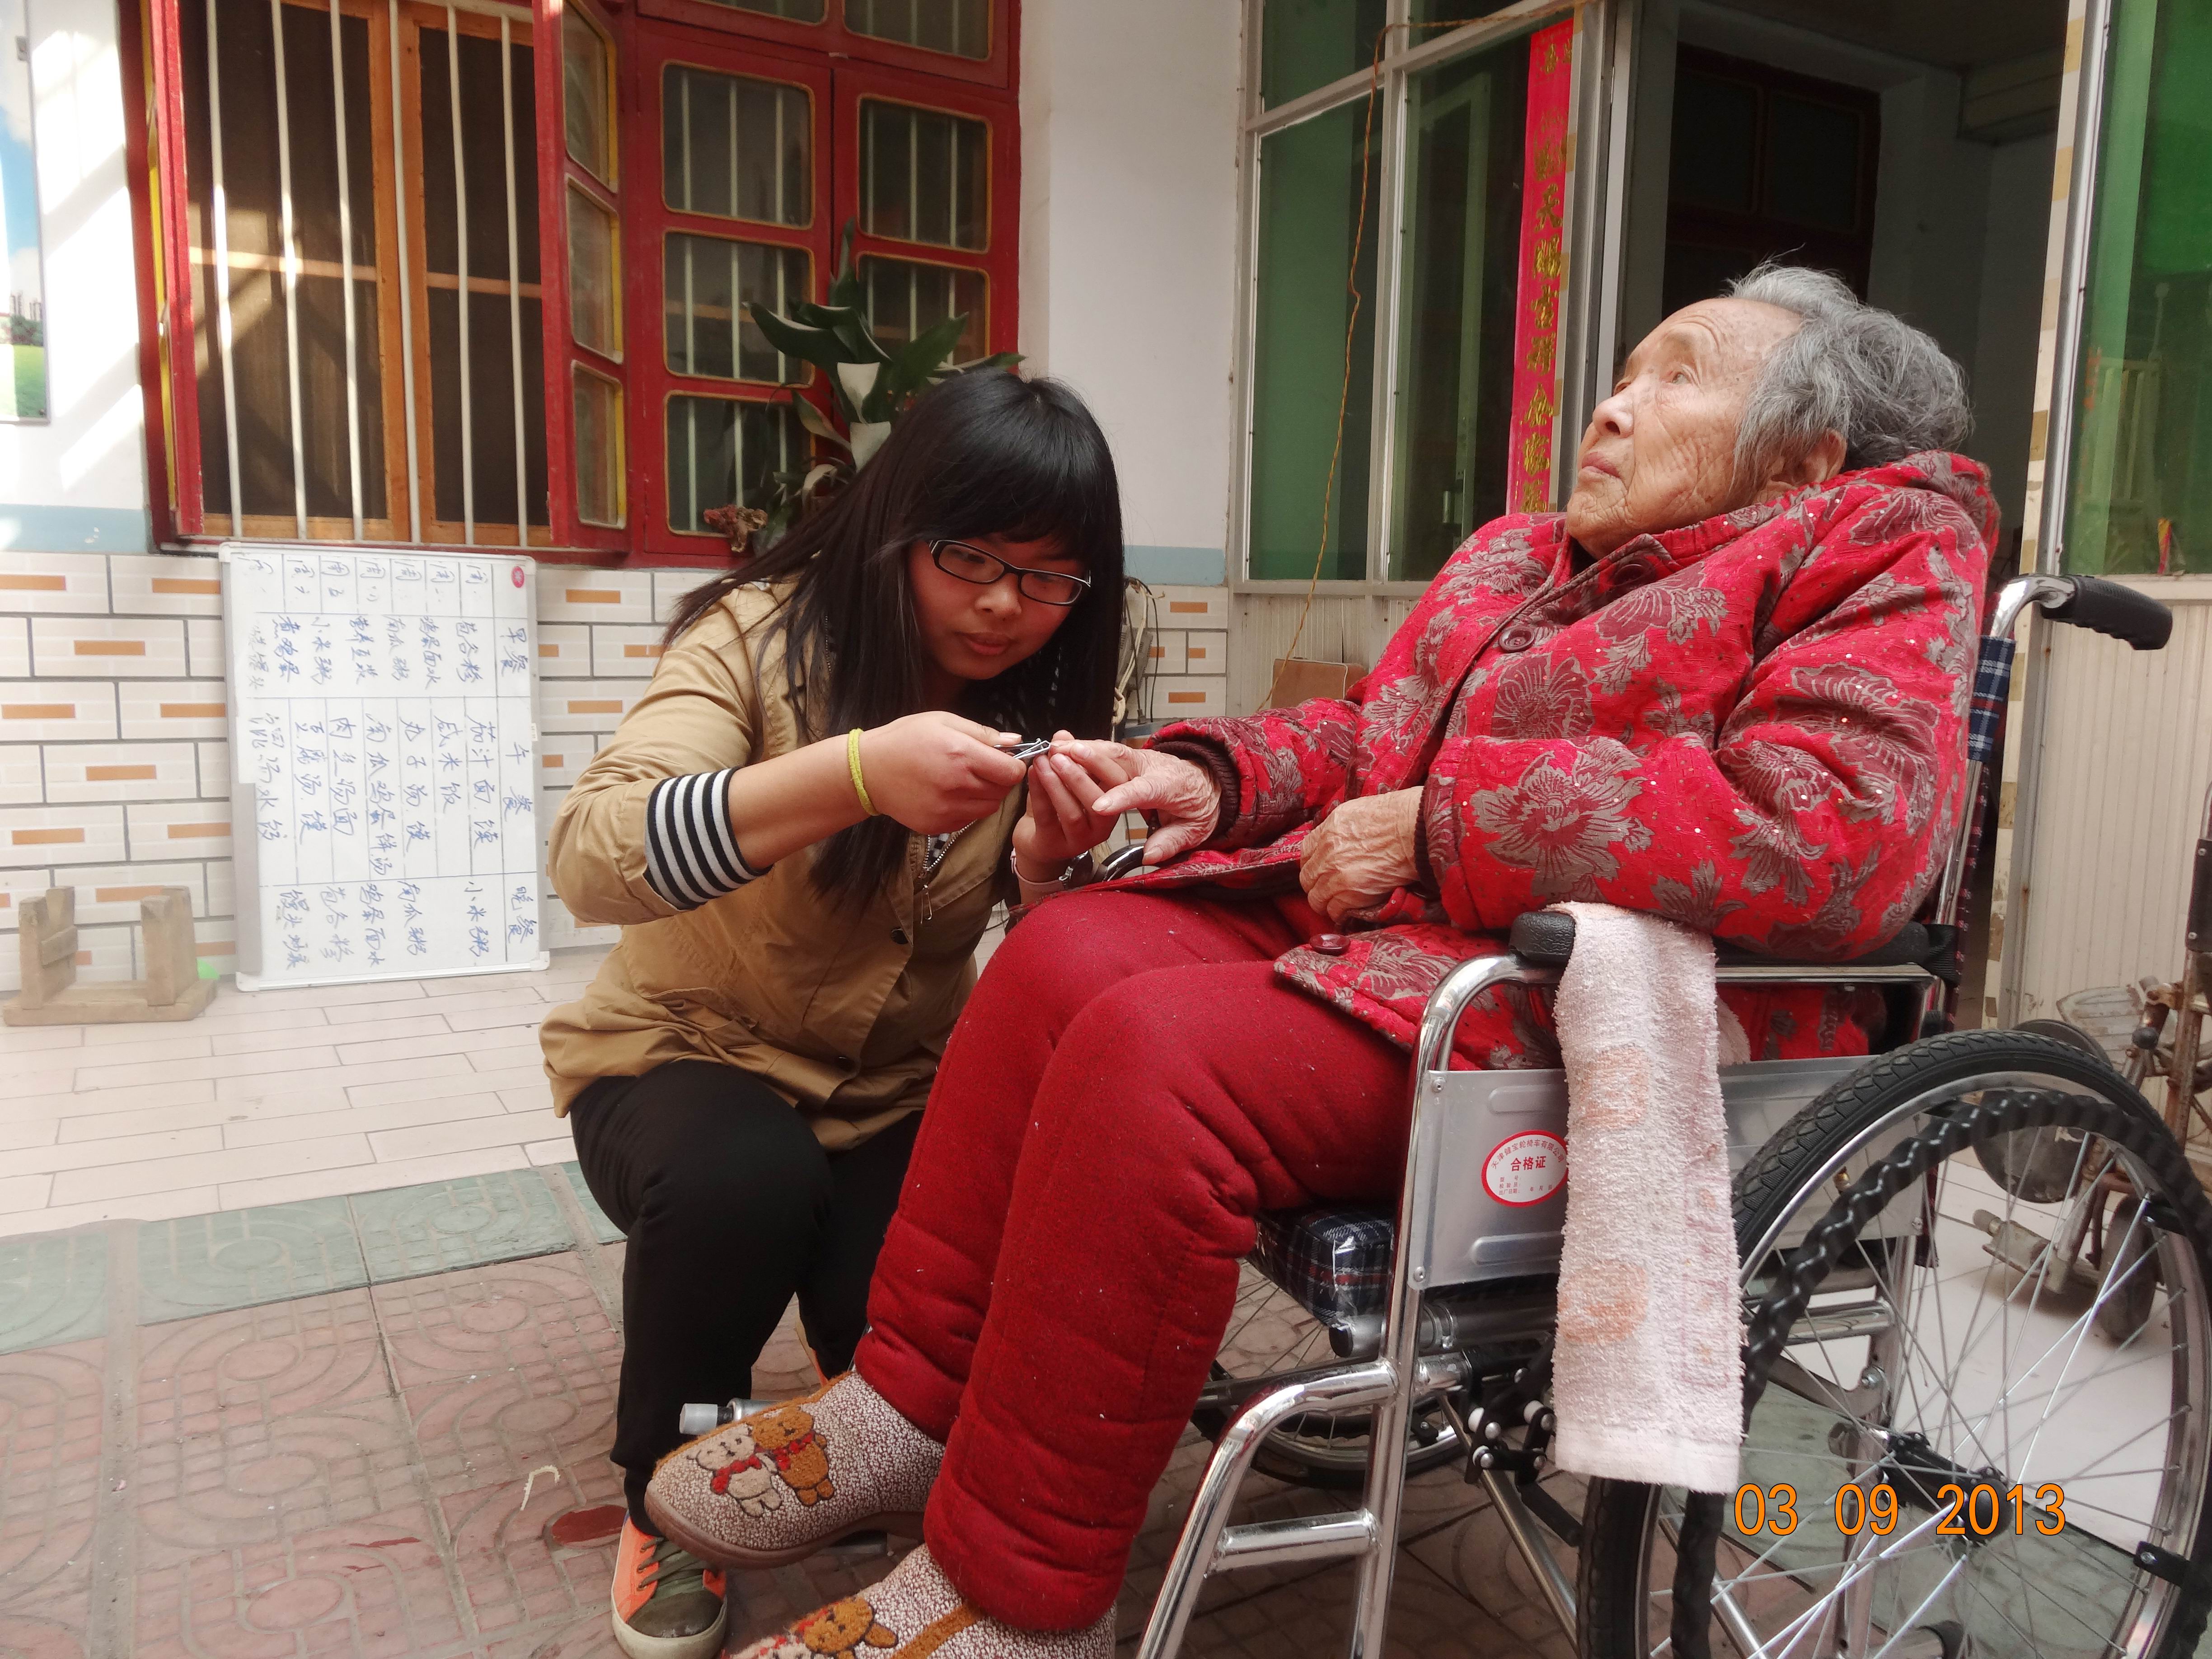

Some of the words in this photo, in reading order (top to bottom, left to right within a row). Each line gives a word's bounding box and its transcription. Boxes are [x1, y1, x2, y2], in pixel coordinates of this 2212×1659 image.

[311, 616, 333, 686] 小米粥
[381, 615, 410, 682] 南瓜粥
[500, 627, 530, 678] 早餐
[433, 715, 463, 815] 咸米饭
[502, 742, 534, 822] 午餐
[397, 880, 426, 956] 南瓜粥
[463, 881, 490, 957] 小米粥
[507, 886, 537, 944] 晚餐
[1491, 1139, 1565, 1170] 天津健宝轮椅车有限公司
[1510, 1155, 1547, 1172] 合格证
